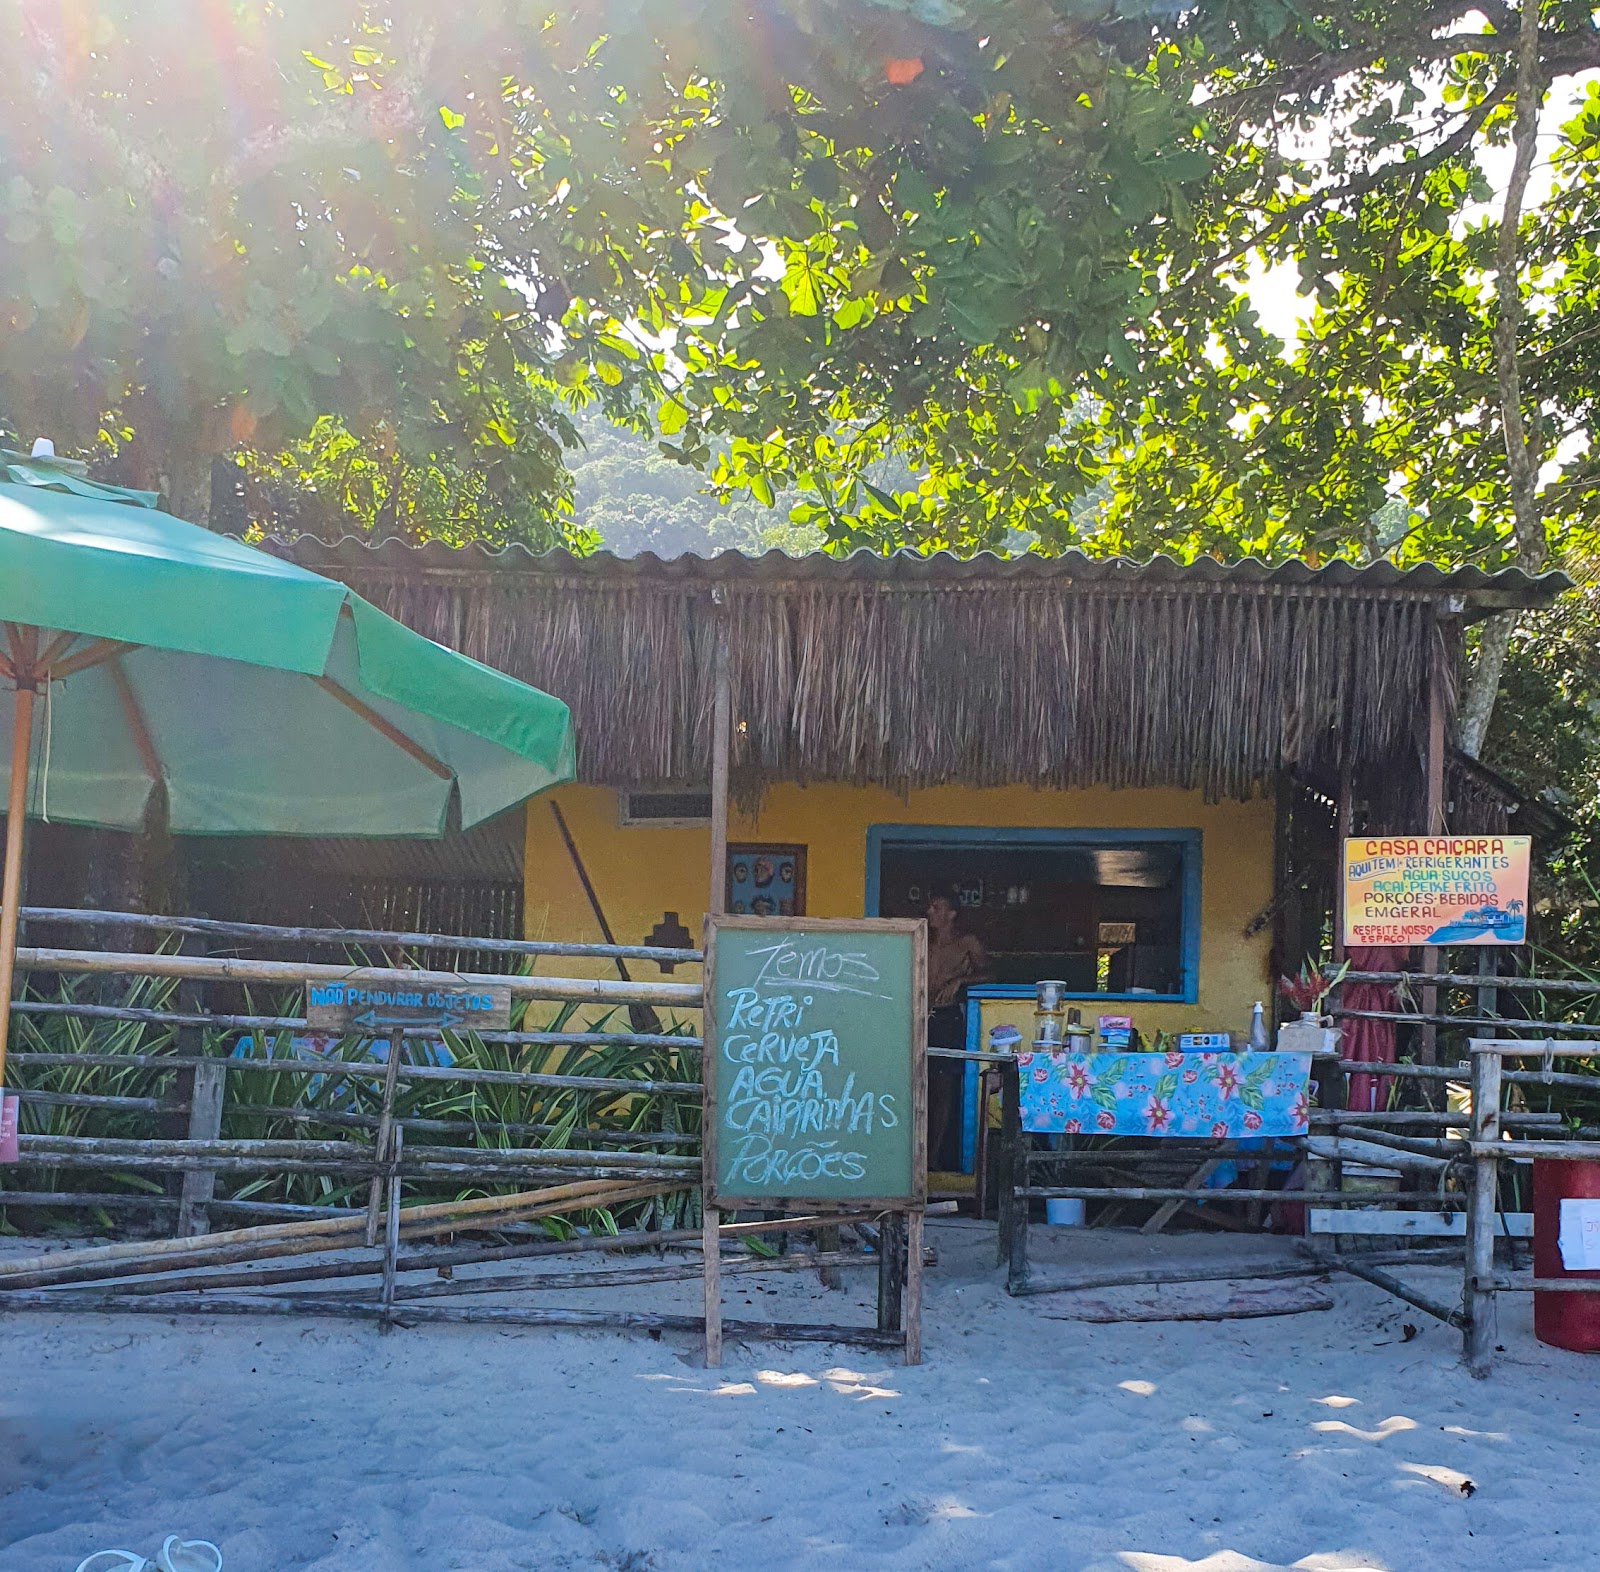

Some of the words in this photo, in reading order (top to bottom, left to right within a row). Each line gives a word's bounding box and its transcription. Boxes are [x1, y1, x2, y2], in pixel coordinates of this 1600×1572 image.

[1365, 839, 1419, 856] CASA
[1424, 839, 1504, 857] CAIÇARA
[1348, 861, 1371, 877] AQUI
[1405, 856, 1510, 870] REFRIGERANTES
[1402, 869, 1438, 881] AGUA
[1442, 869, 1493, 882] SUCOS
[1410, 881, 1450, 893] PEIXE
[1455, 881, 1497, 893] FRITO
[1439, 893, 1499, 906] BEBIDAS
[1352, 925, 1399, 936] RESPEITE
[1401, 925, 1434, 935] NOSSO
[347, 987, 423, 1007] PENDURAR
[728, 1065, 824, 1101] AGUA
